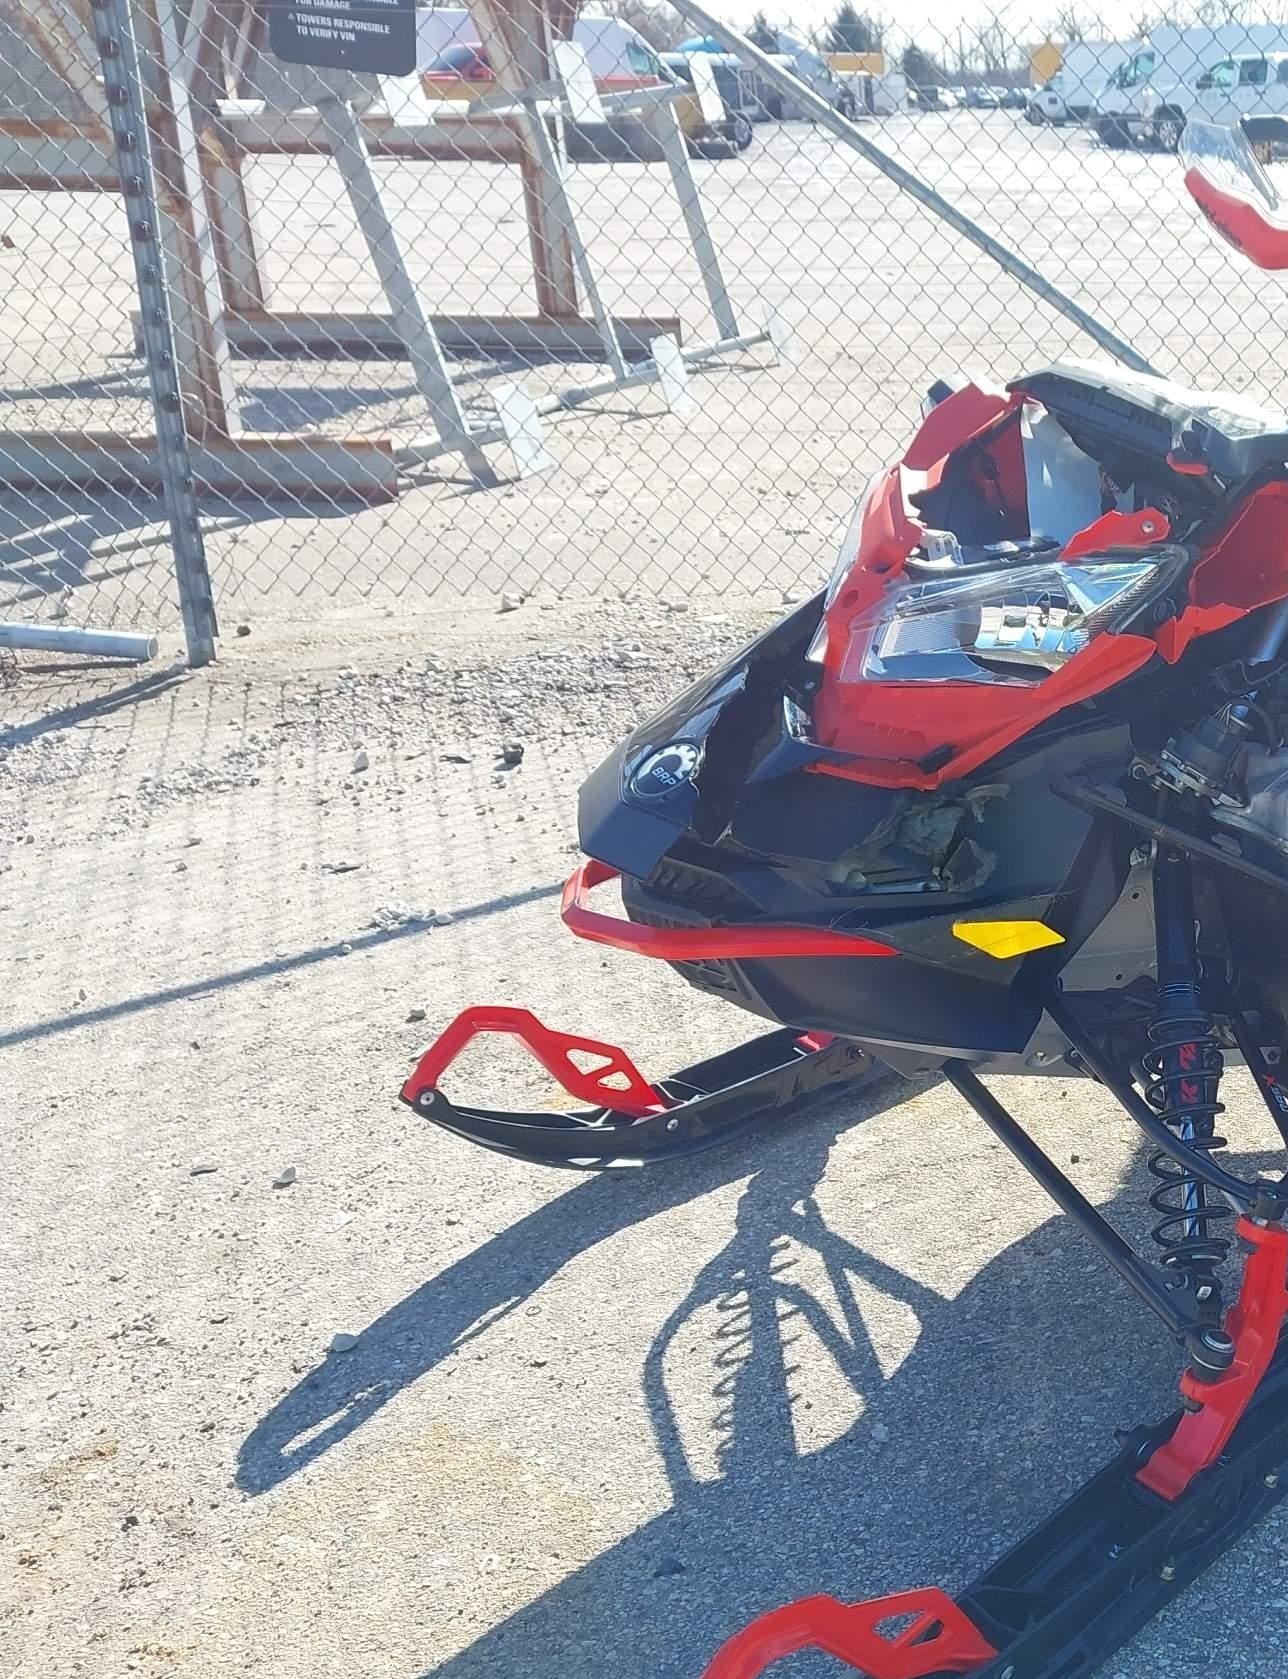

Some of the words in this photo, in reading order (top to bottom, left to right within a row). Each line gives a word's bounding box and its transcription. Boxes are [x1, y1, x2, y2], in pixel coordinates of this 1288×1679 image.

[296, 13, 332, 26] TOWERS
[333, 18, 391, 34] RESPONSIBLE
[296, 25, 308, 35] TO
[309, 27, 339, 39] VERIFY
[340, 31, 356, 41] VIN
[652, 766, 677, 786] BRP
